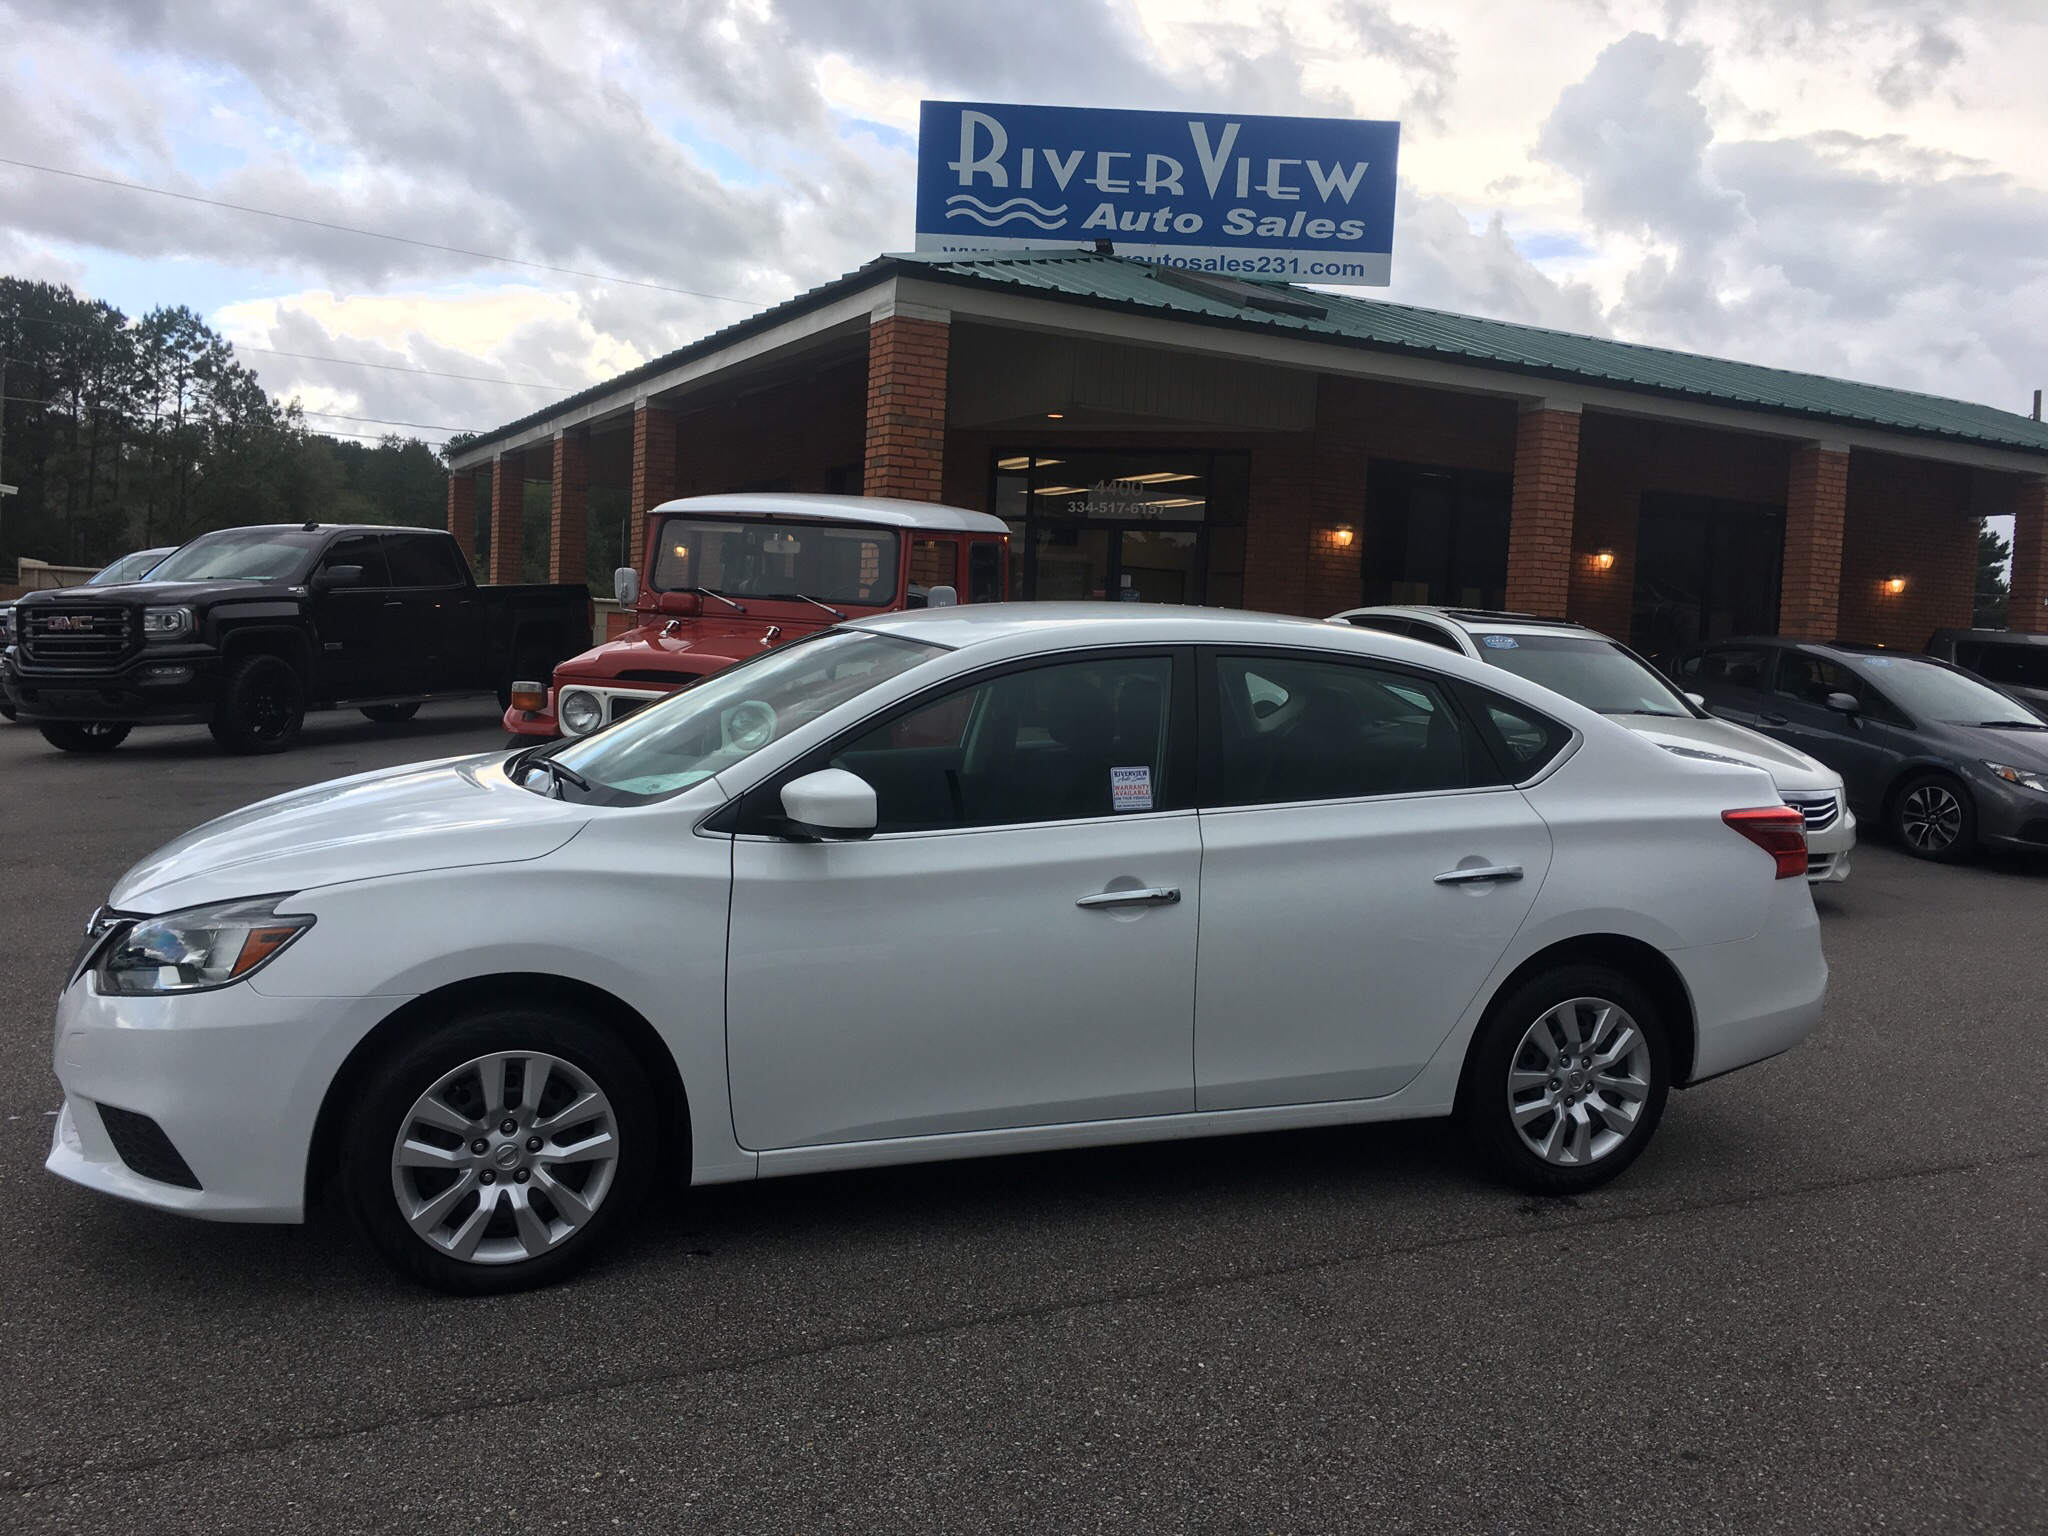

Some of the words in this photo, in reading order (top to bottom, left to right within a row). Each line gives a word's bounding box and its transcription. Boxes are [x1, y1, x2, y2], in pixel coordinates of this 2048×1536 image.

[1080, 203, 1204, 234] Auto
[1222, 208, 1366, 240] Sales
[1094, 479, 1144, 496] 4400
[1067, 501, 1166, 515] 334-517-6157
[48, 616, 93, 629] GMC
